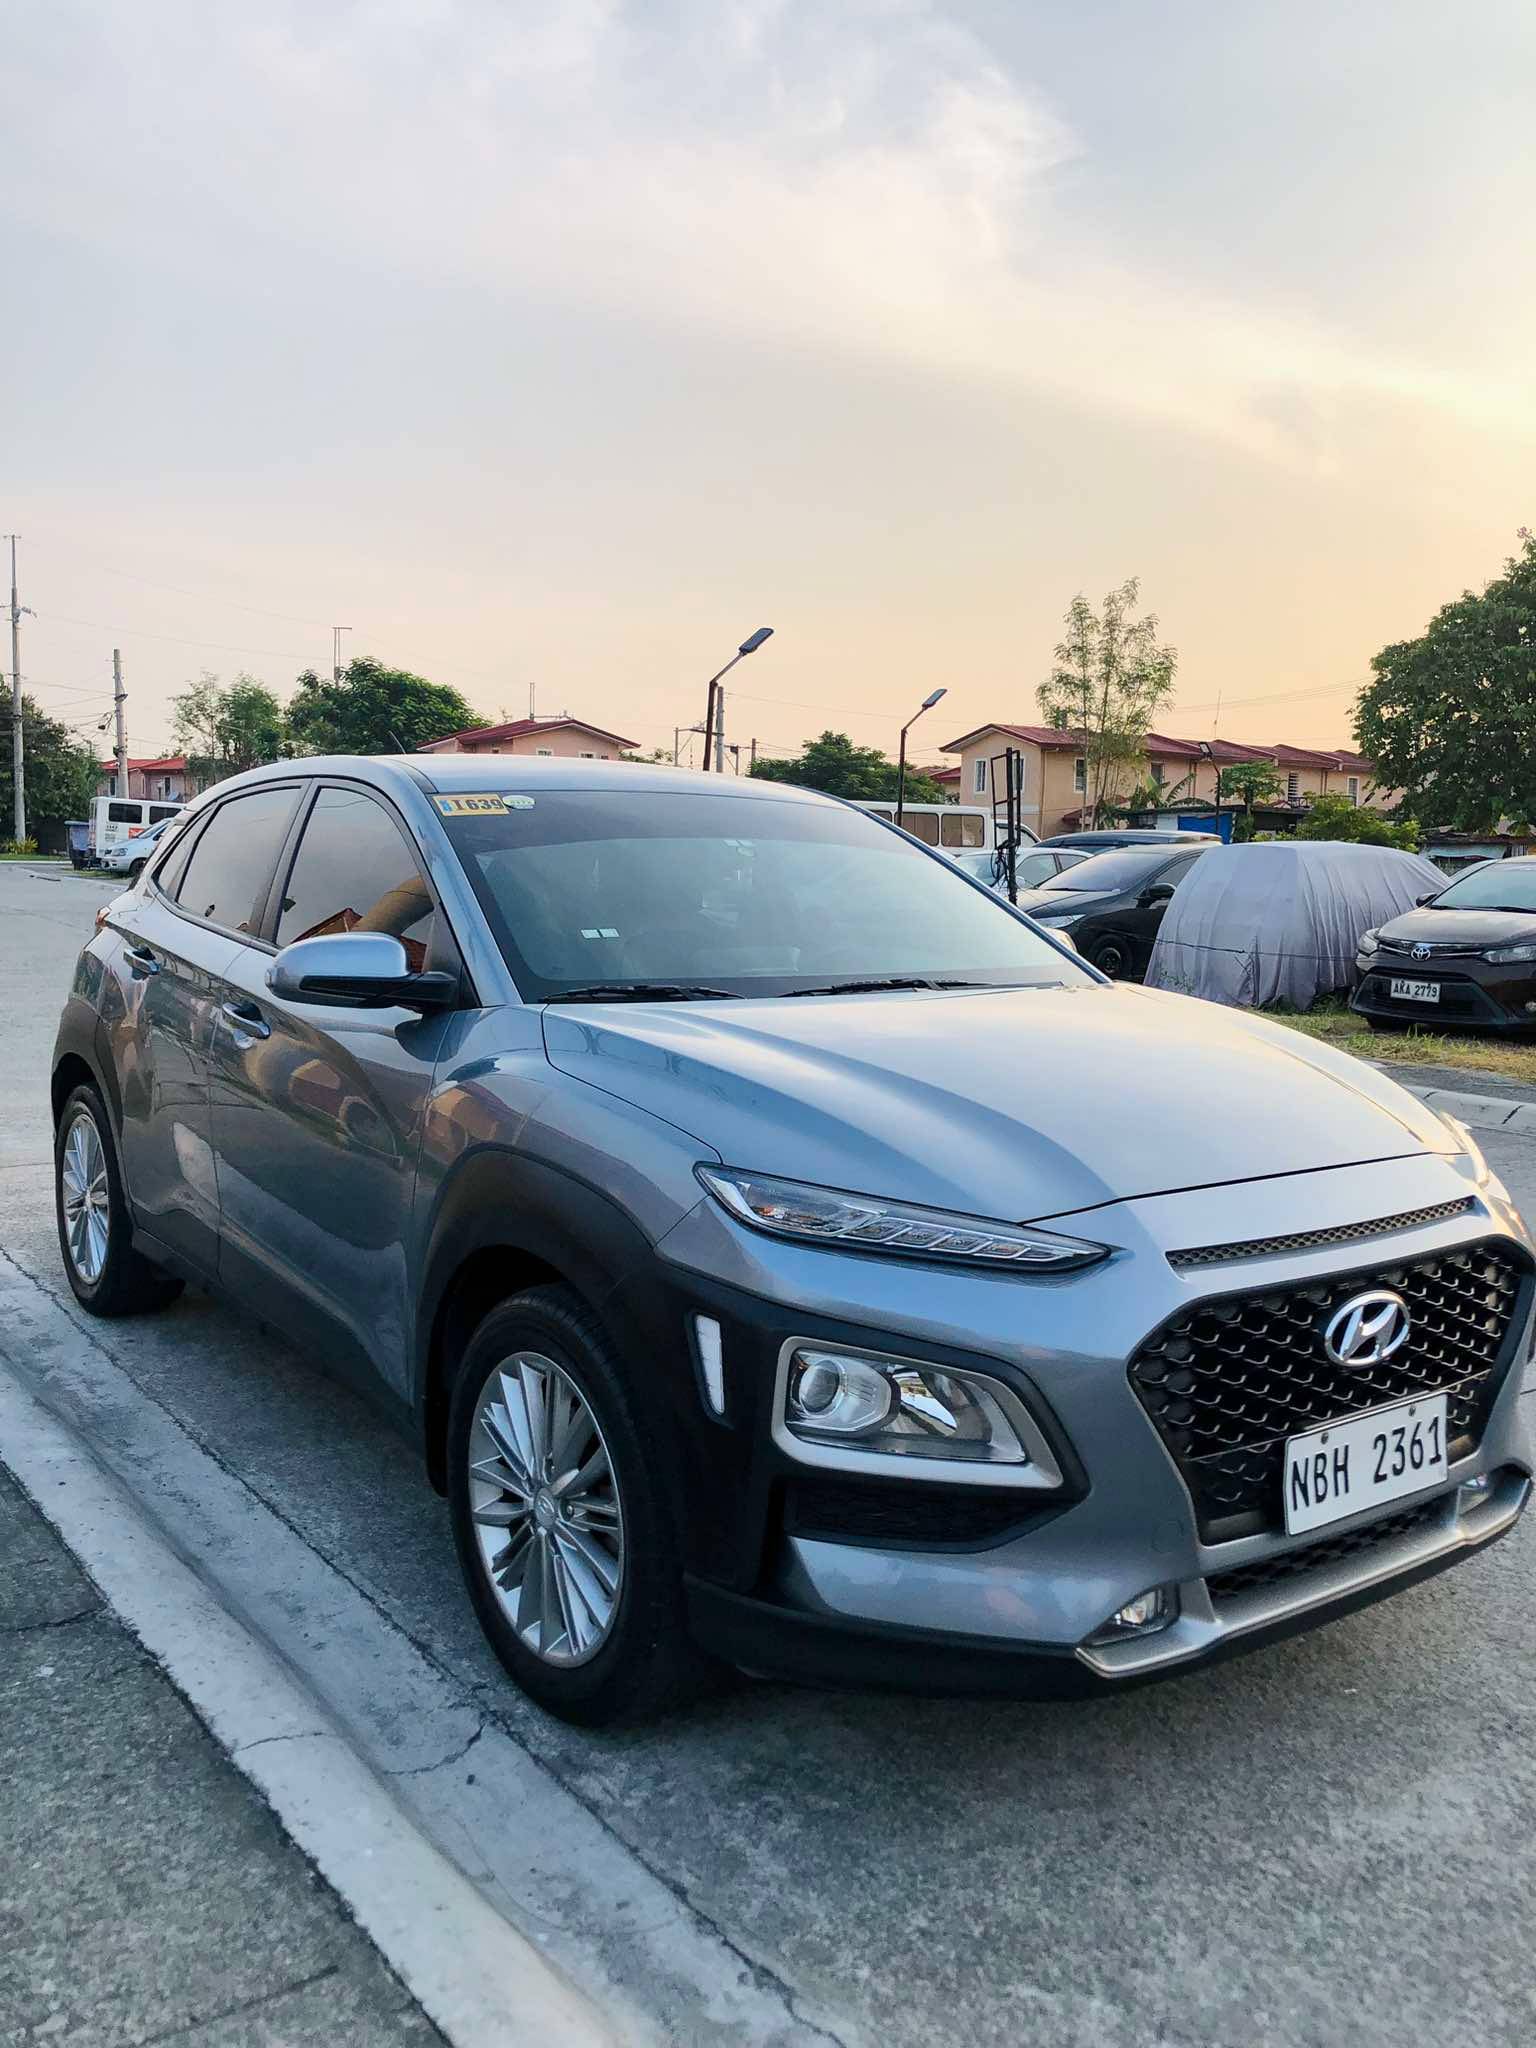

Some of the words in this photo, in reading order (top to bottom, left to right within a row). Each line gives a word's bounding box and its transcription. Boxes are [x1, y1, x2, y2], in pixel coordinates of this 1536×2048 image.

[1393, 983, 1410, 995] AKA
[1414, 984, 1438, 998] 2779
[1292, 1444, 1350, 1511] NBH
[1373, 1416, 1442, 1484] 2361
